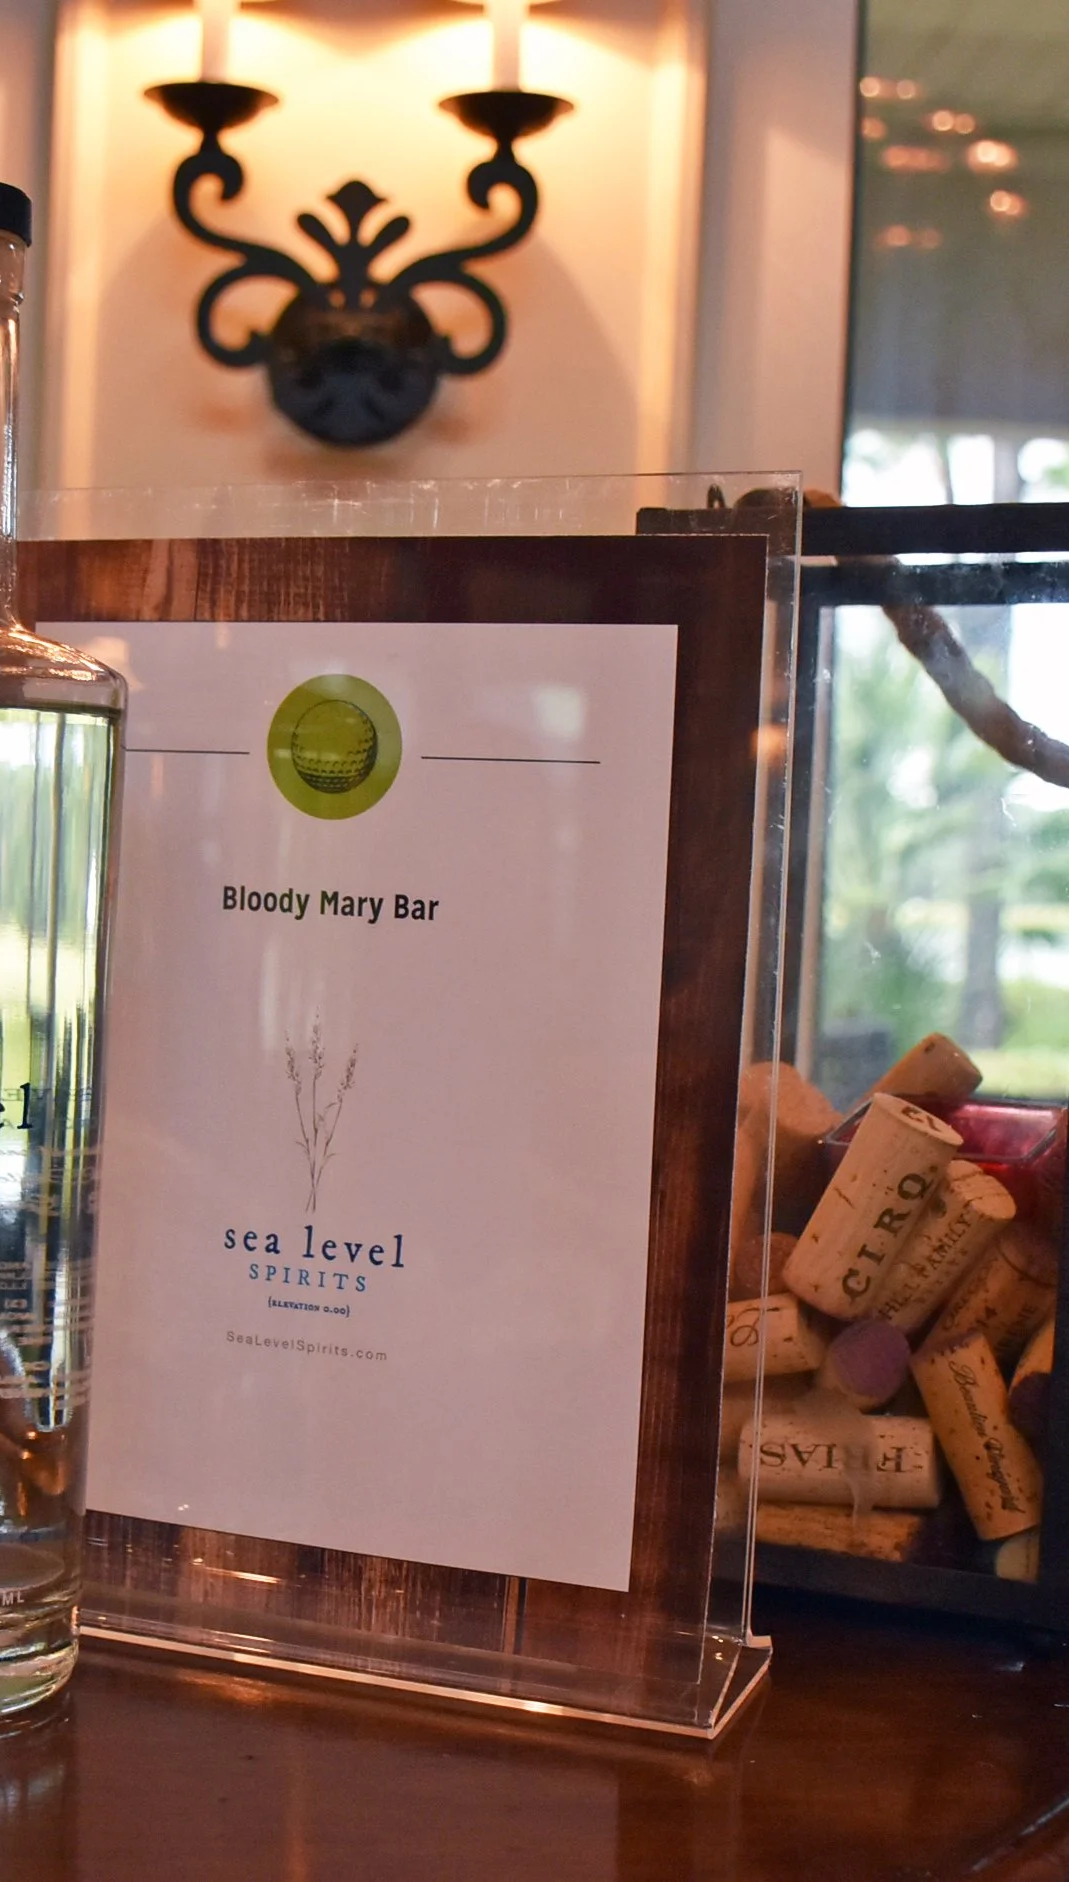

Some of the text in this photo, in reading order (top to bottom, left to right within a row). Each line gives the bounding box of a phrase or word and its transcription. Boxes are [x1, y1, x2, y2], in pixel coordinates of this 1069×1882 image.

[222, 885, 440, 925] Bloody Mary Bar
[223, 1224, 406, 1268] sea level
[248, 1263, 367, 1293] SPIRITS
[225, 1330, 388, 1362] SeaLevelSpirits.com
[0, 1591, 26, 1607] ML
